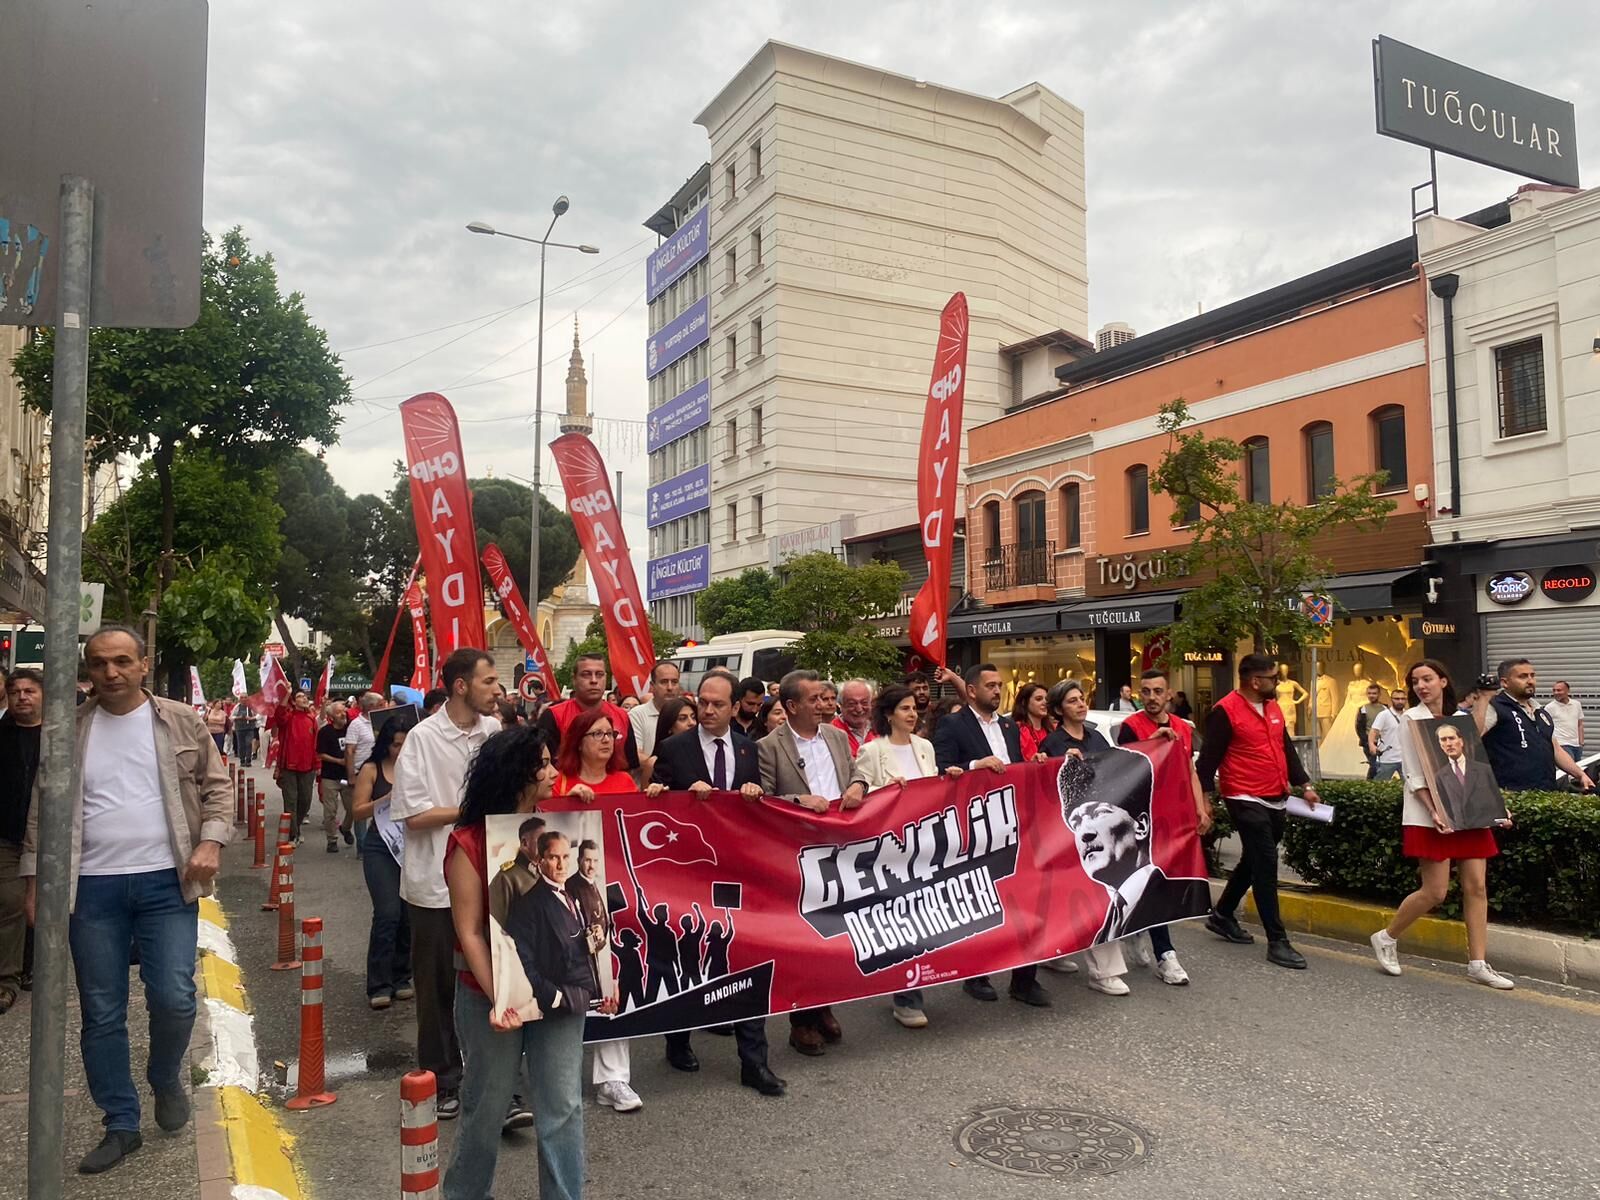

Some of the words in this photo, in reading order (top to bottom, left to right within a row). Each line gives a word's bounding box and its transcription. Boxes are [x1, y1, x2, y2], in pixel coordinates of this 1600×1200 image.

[1401, 78, 1562, 157] TUĞCULAR
[1490, 577, 1529, 594] STORKS
[1544, 577, 1591, 590] REGOLD
[1088, 610, 1141, 625] TUĞCULAR
[972, 622, 1012, 635] TUĞCULAR
[704, 977, 753, 1006] BANDIRMA
